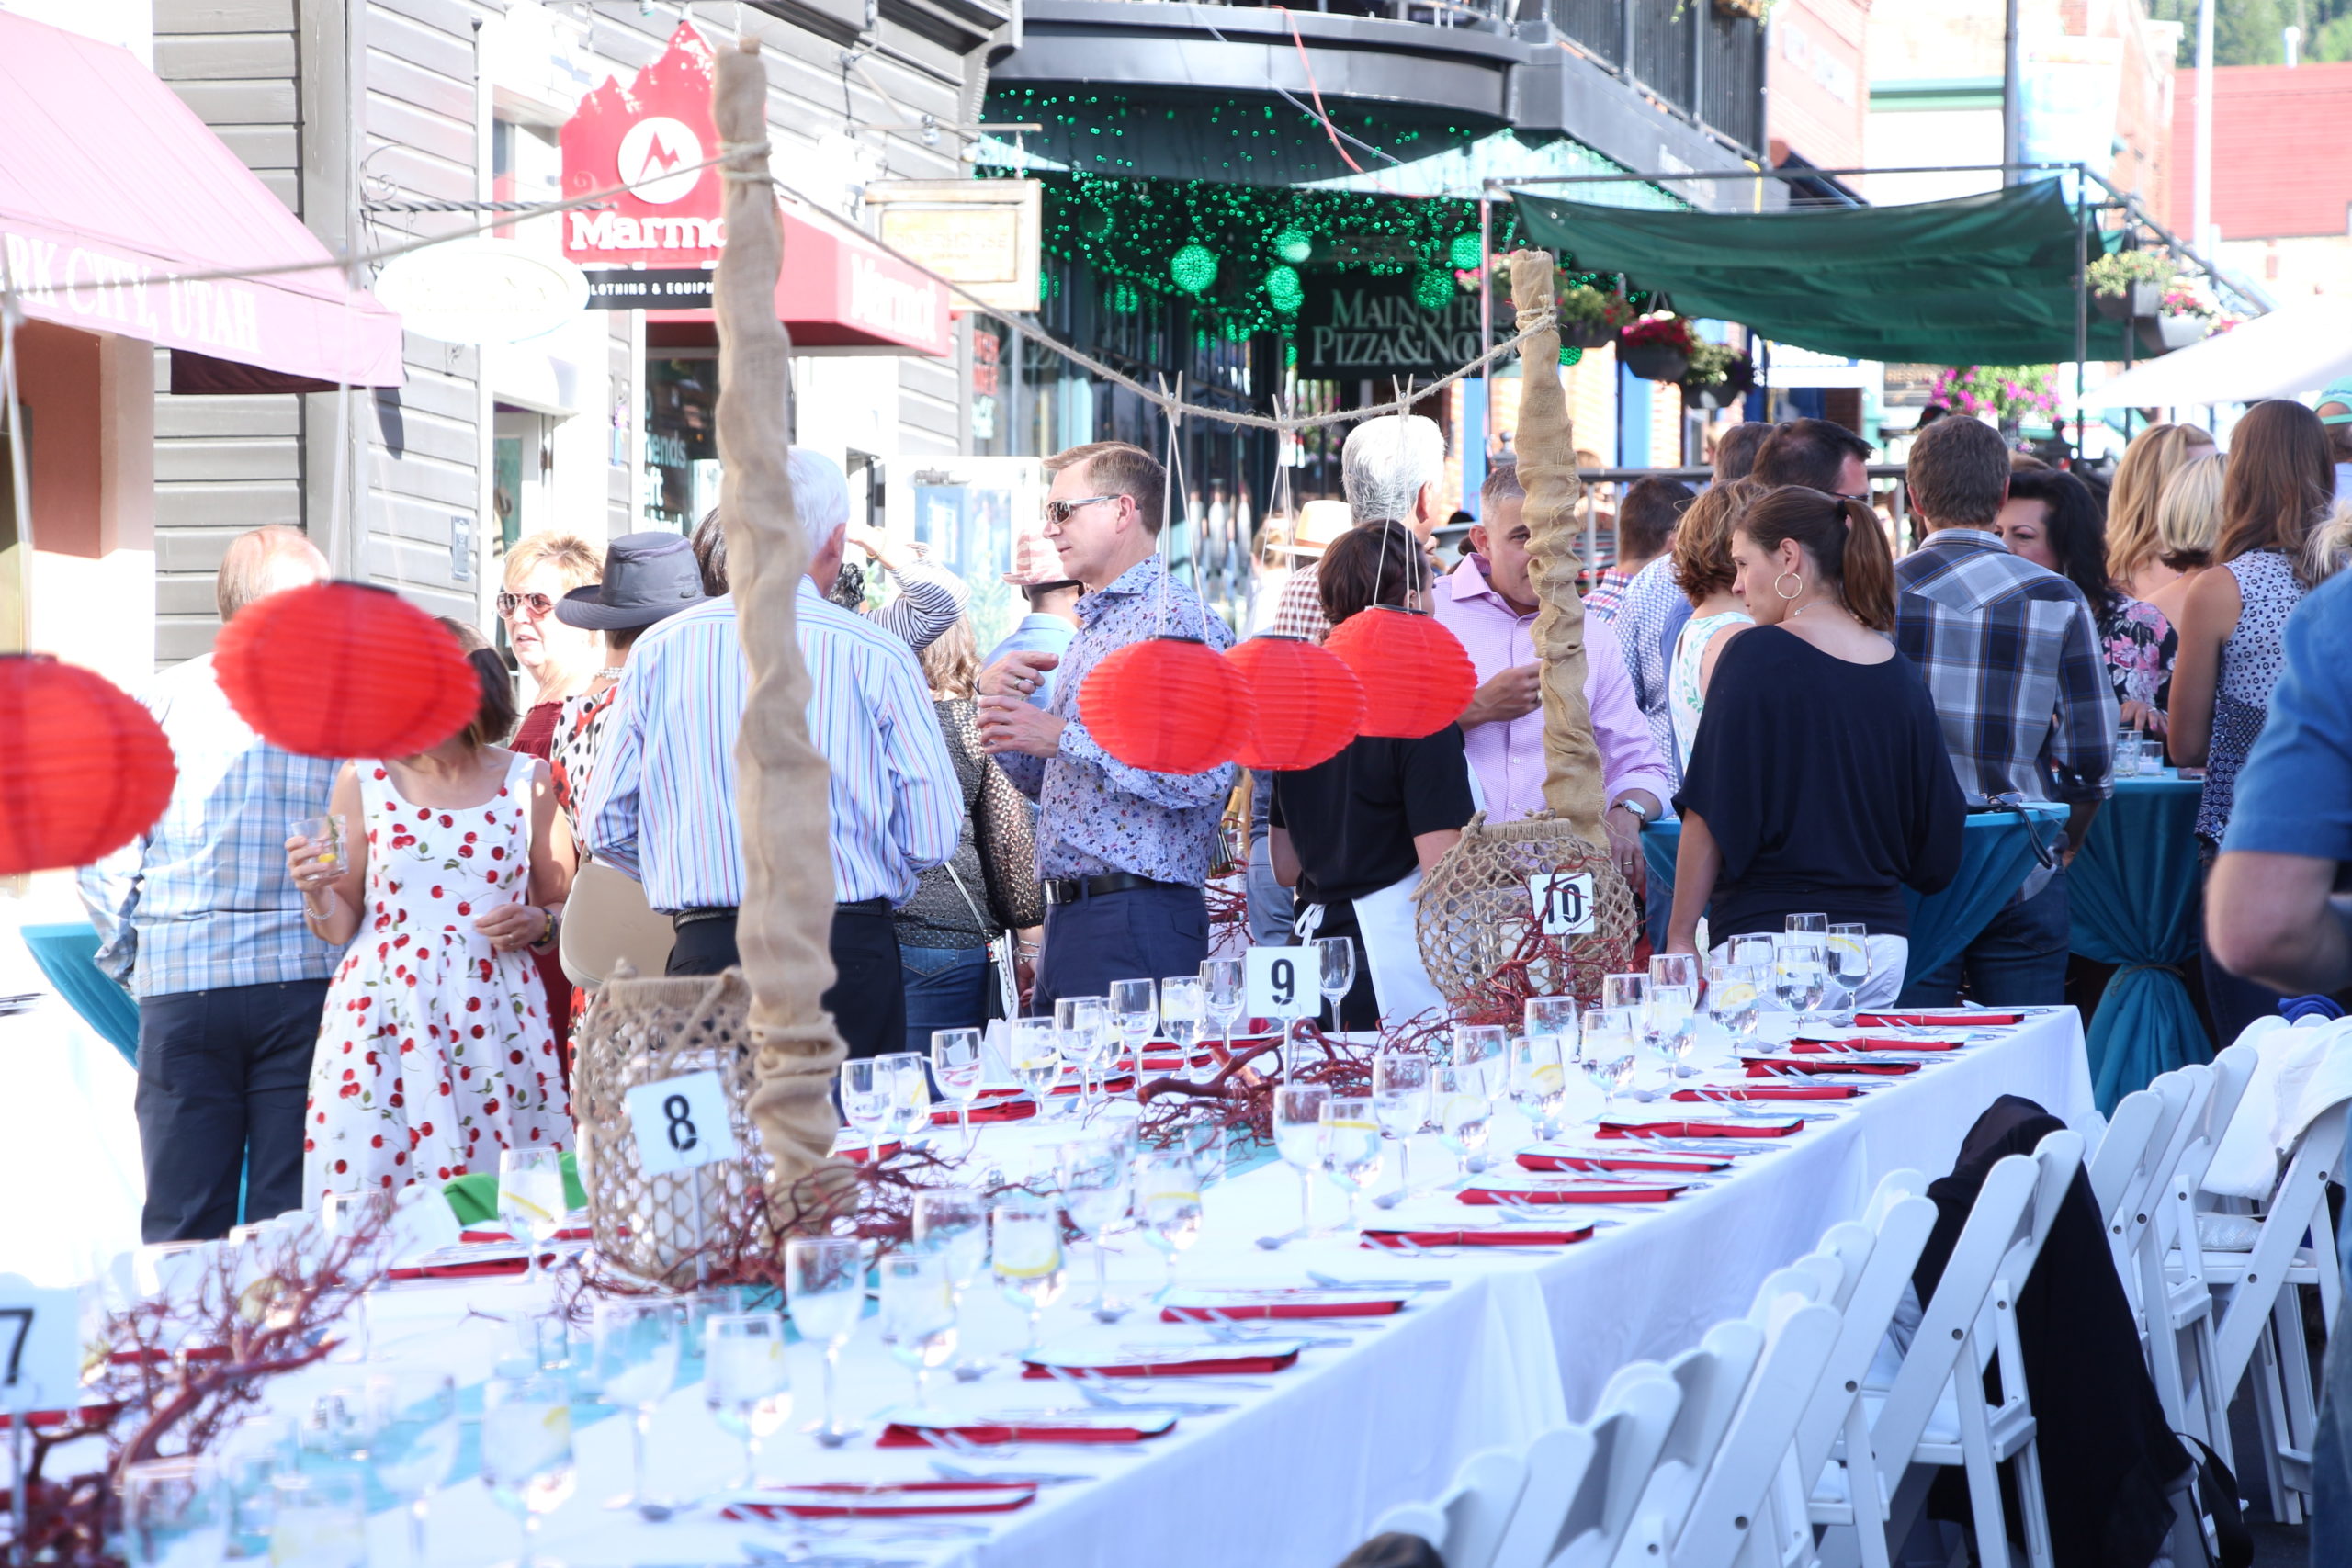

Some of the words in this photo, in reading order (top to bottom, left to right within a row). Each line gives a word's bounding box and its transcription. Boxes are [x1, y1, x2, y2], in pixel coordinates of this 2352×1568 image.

[568, 211, 728, 251] Marmo
[3, 231, 59, 308] RK
[166, 272, 262, 354] UTAH
[590, 282, 647, 296] LOTHING
[651, 282, 662, 295] &
[666, 281, 714, 296] EQUIPM
[851, 253, 937, 344] Marmot
[1542, 883, 1582, 924] 10
[1271, 957, 1295, 1004] 9
[663, 1094, 697, 1152] 8
[0, 1308, 34, 1386] 7
